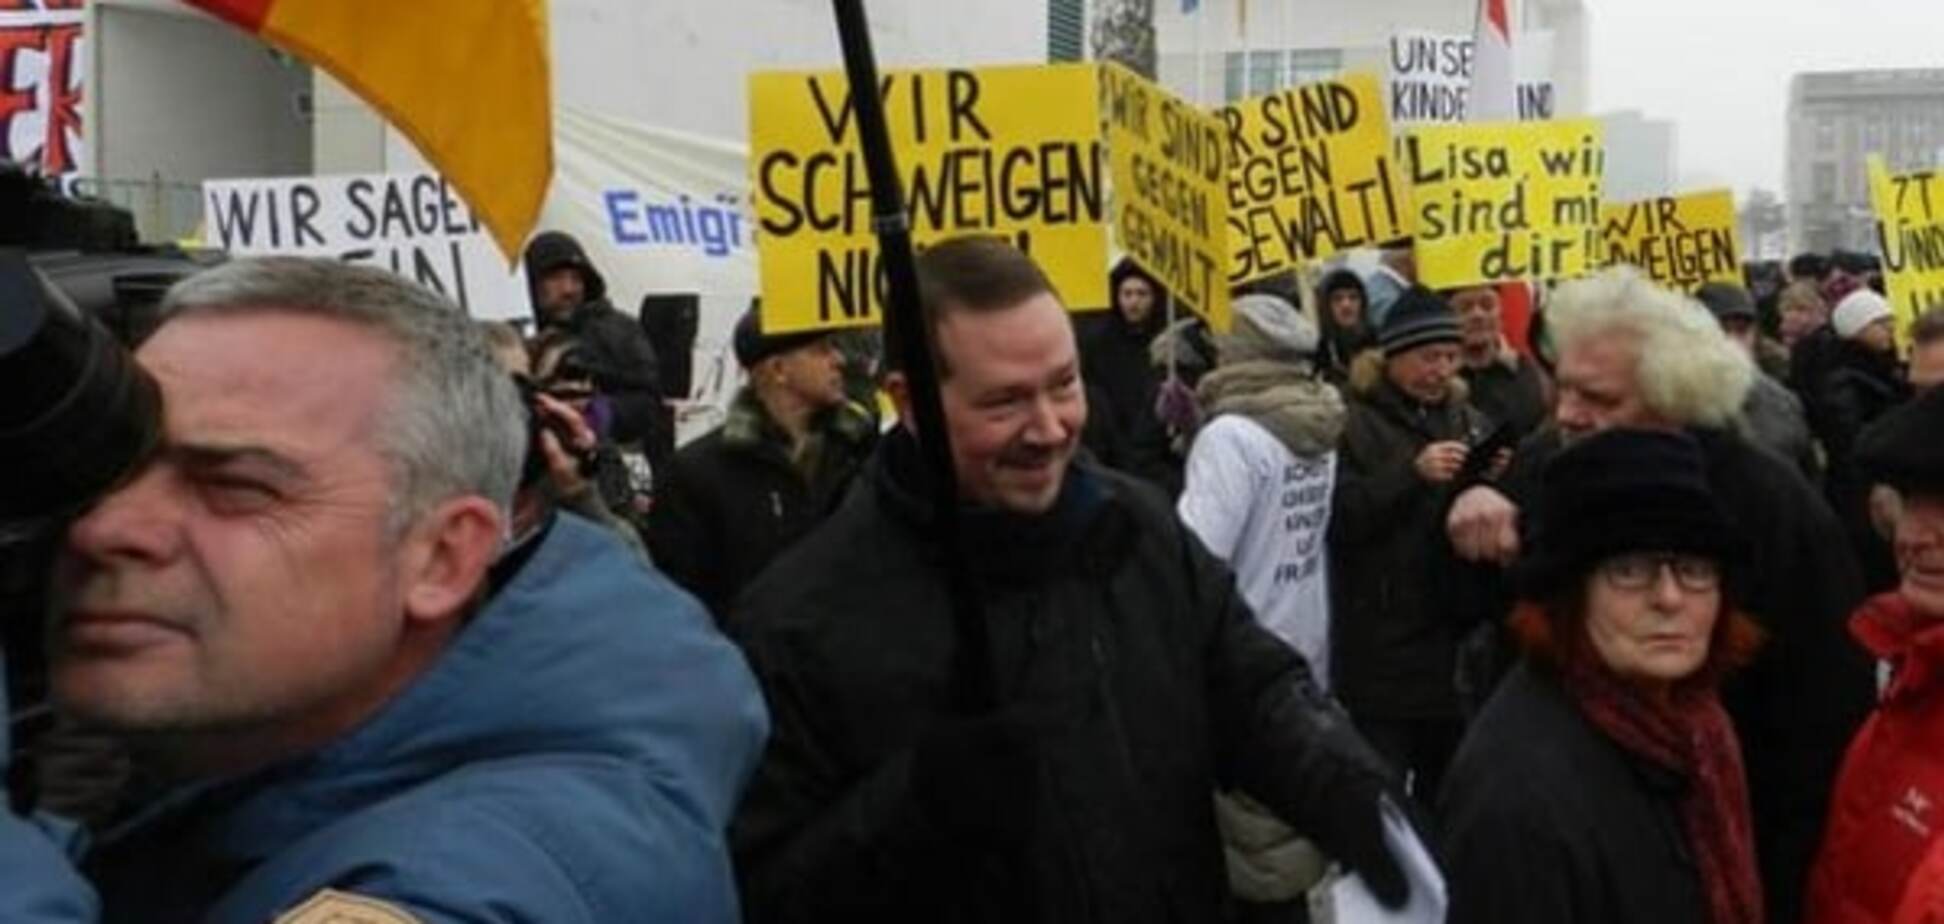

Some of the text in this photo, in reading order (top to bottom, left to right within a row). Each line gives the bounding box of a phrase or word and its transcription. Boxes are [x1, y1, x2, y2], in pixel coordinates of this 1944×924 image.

[807, 70, 992, 145] WIR
[1161, 98, 1221, 182] SIND
[1261, 82, 1358, 148] SIND
[211, 175, 480, 248] WIR SAGE
[758, 142, 1104, 237] SCHWEIGEN
[1131, 152, 1209, 240] GEGEN
[1420, 183, 1530, 240] sind
[1121, 202, 1216, 312] GEWALT
